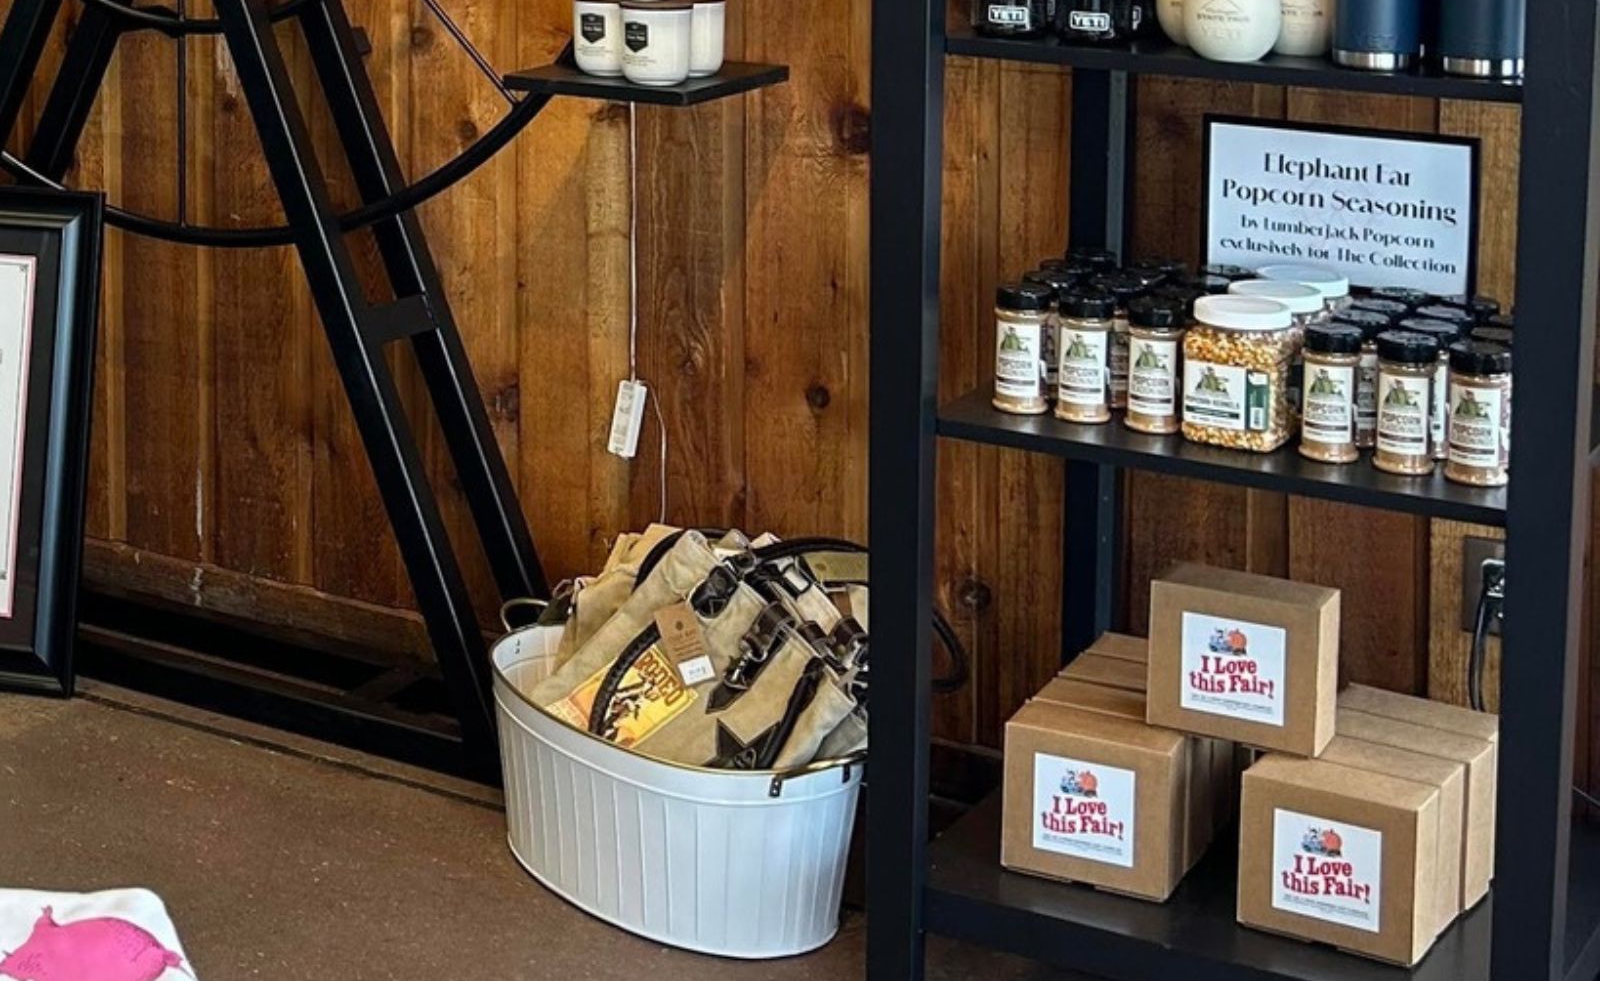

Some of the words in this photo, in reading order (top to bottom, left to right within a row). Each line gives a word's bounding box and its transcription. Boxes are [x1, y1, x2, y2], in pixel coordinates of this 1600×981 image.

[1074, 15, 1106, 28] YETI
[1263, 152, 1368, 183] Elephant
[1376, 163, 1411, 187] Ear
[1222, 178, 1324, 208] Popcorn
[1331, 190, 1457, 226] Seasoning
[1241, 214, 1258, 229] by
[1264, 216, 1360, 241] Lumberjack
[1363, 227, 1435, 249] Popcorn
[1220, 237, 1303, 257] exclusively
[1308, 246, 1329, 260] for
[1337, 248, 1365, 263] The
[1369, 251, 1456, 274] Collection
[1201, 655, 1209, 673] I
[1214, 657, 1257, 674] Love
[1189, 671, 1225, 693] this
[1229, 675, 1274, 700] Fair!
[1053, 795, 1061, 814] I
[1065, 797, 1107, 815] Love
[1041, 811, 1076, 834] this
[1079, 816, 1124, 841] Fair!
[1294, 854, 1302, 873] I
[1307, 857, 1353, 876] Love
[1281, 870, 1319, 895] this
[1323, 877, 1370, 904] Fair!
